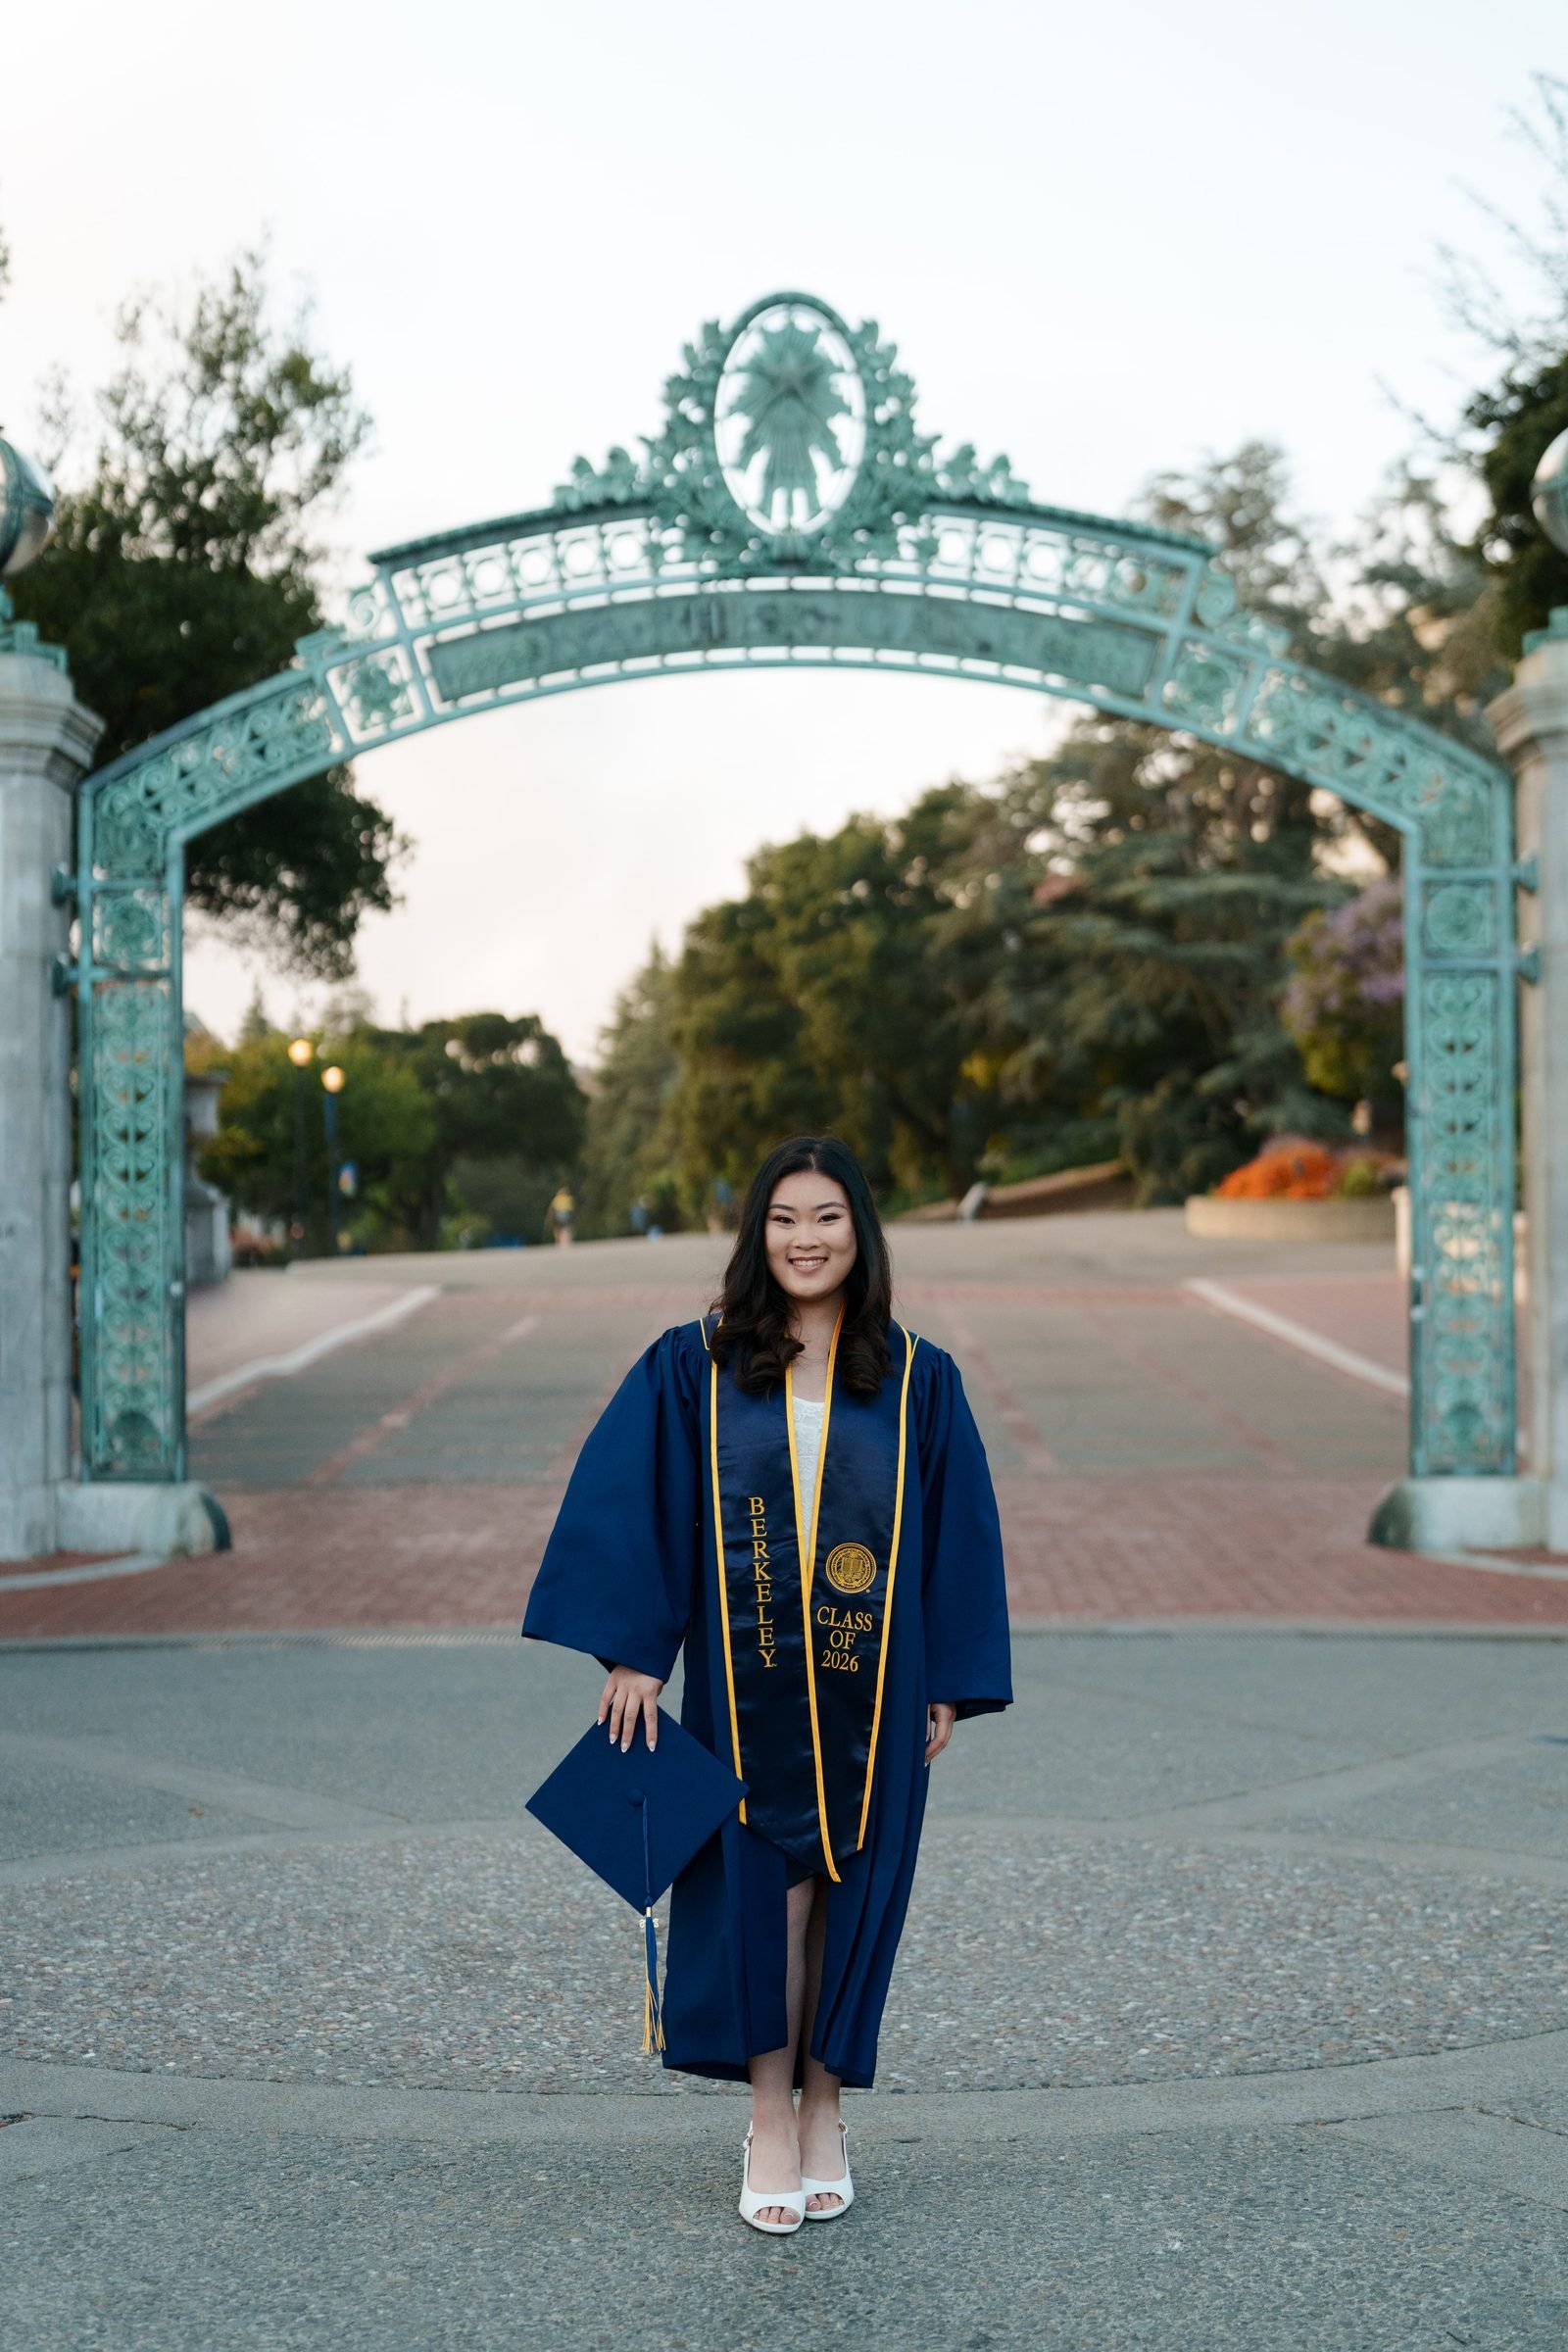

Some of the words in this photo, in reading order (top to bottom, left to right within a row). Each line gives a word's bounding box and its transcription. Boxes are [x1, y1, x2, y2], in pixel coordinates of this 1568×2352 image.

[749, 1496, 776, 1668] BERKELEY
[816, 1606, 873, 1632] CLASS
[829, 1630, 856, 1649] OF
[821, 1650, 859, 1672] 2026
